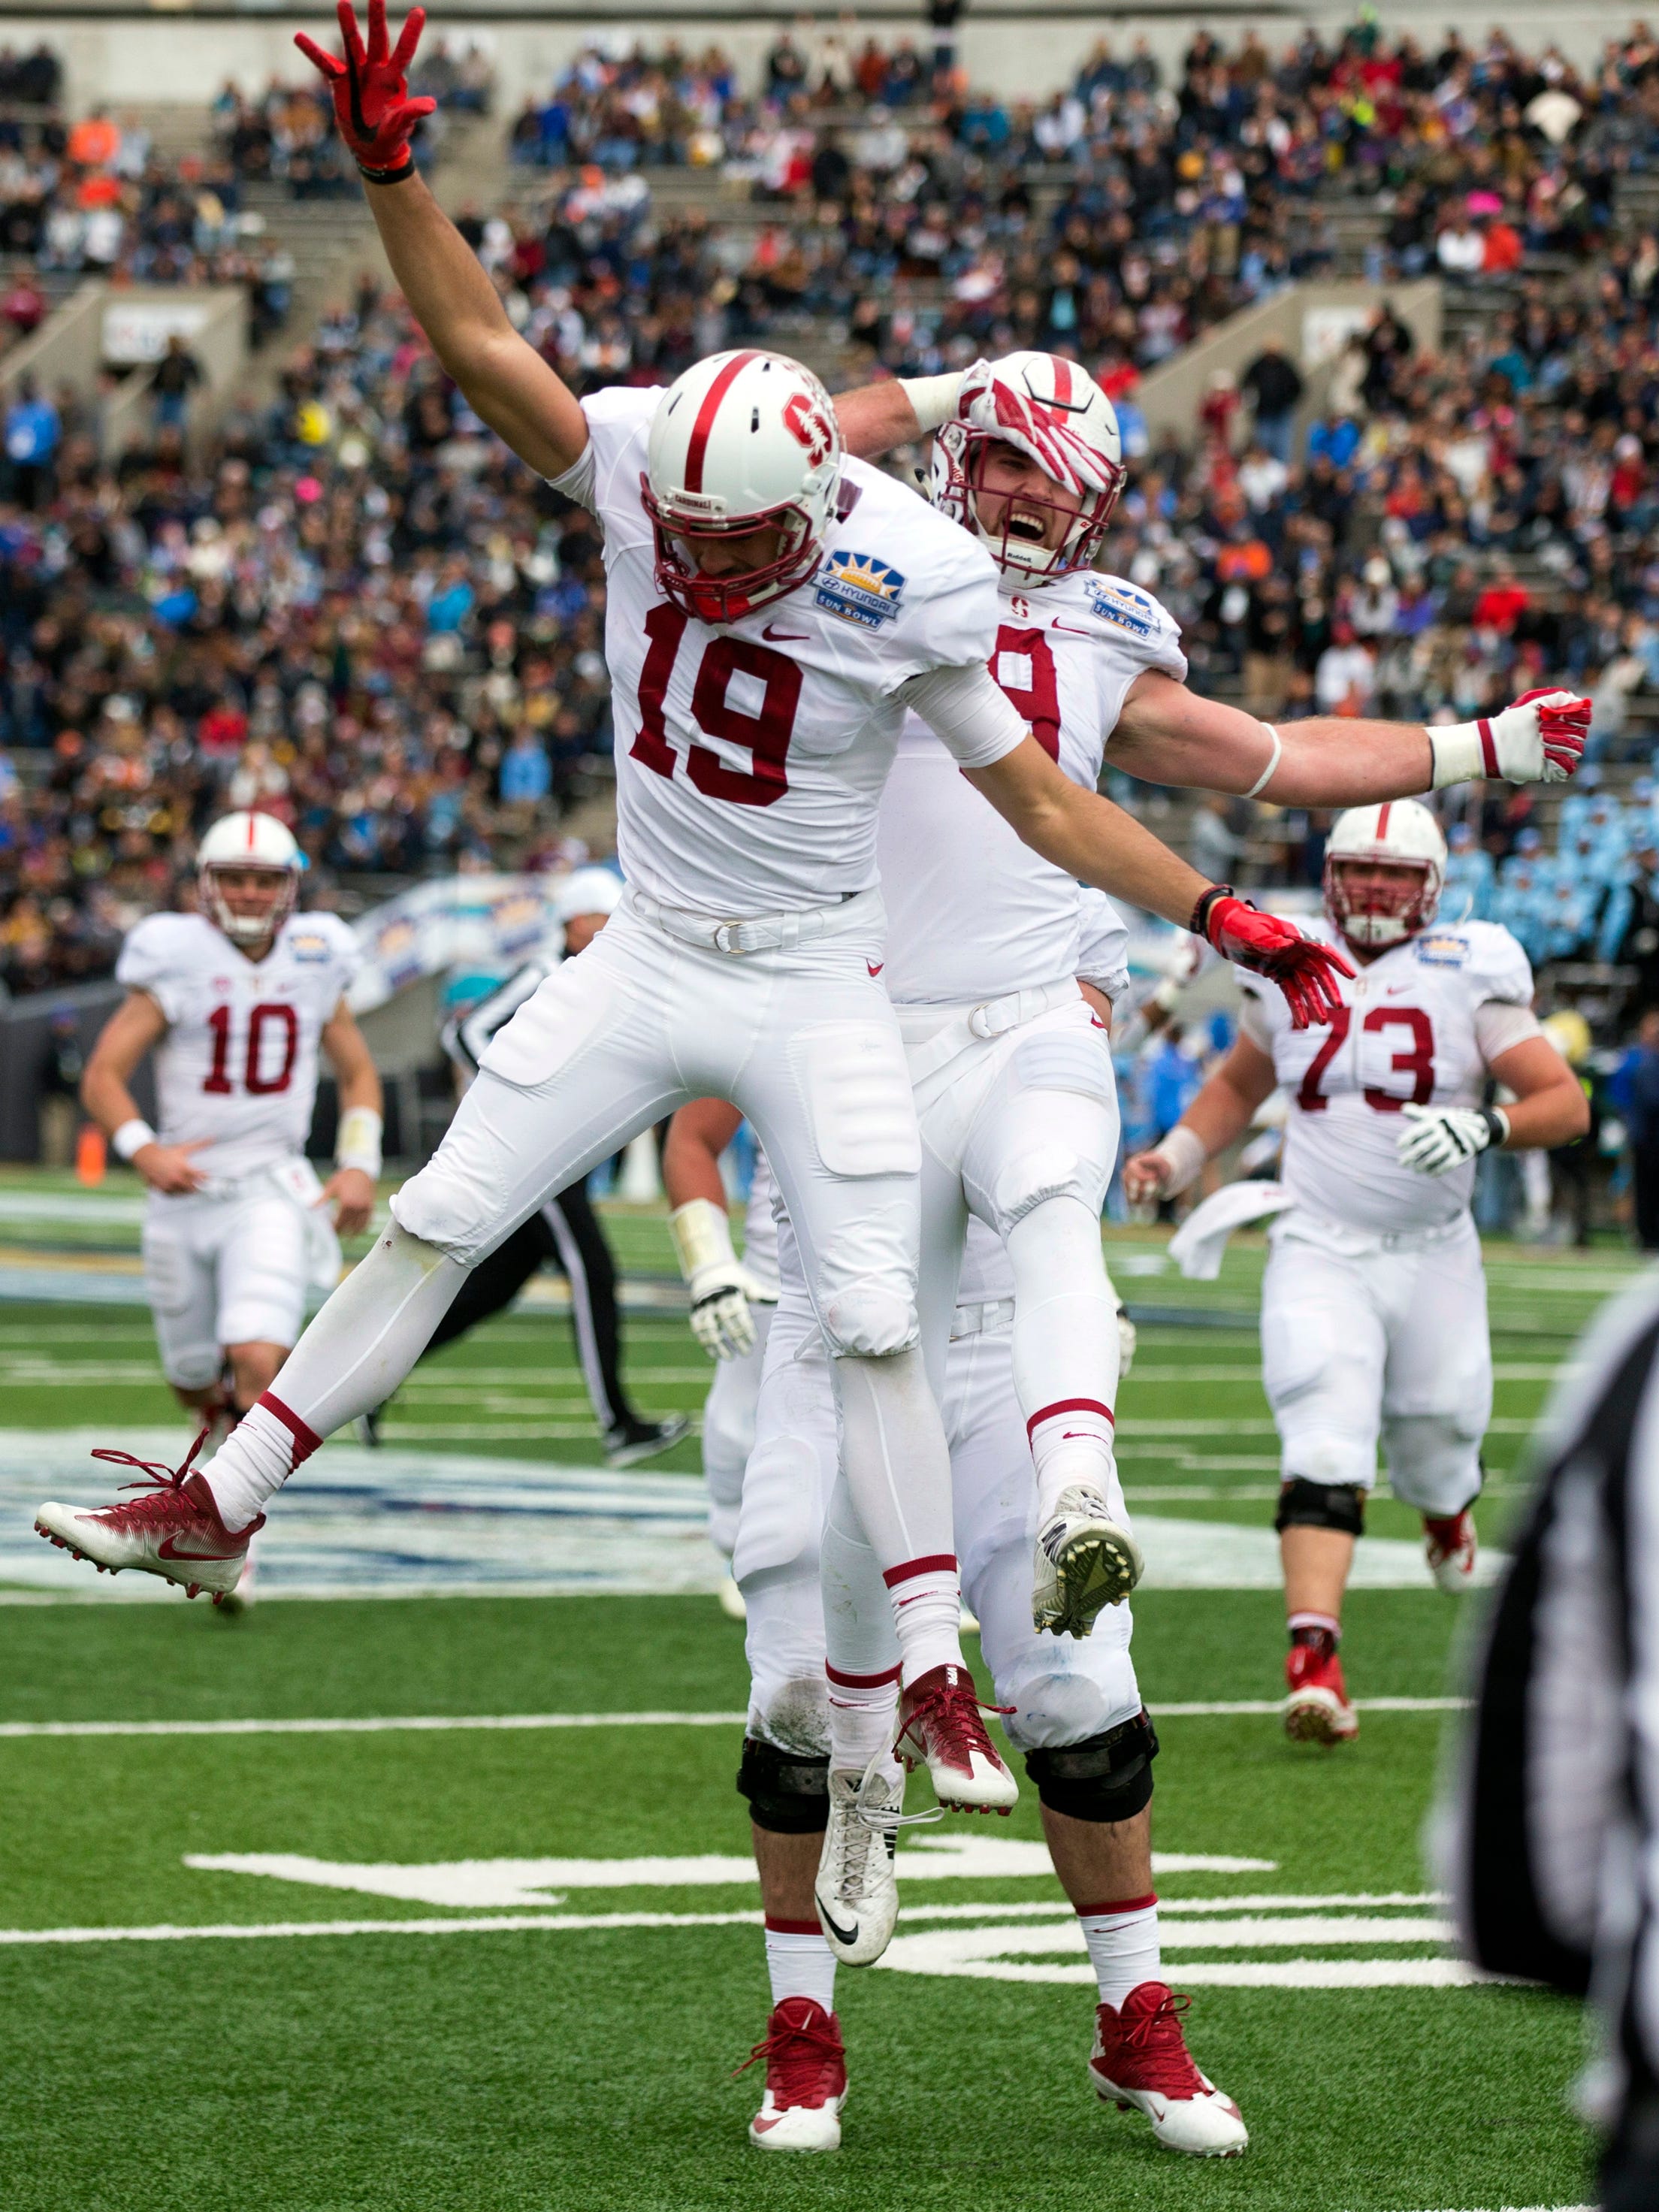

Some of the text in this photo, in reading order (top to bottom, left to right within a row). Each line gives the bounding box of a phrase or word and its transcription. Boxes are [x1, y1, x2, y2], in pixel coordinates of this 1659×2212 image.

[817, 595, 878, 627] SUN BOWL
[841, 585, 890, 612] HYUNDAI
[1095, 604, 1147, 636] SUN BOWL
[629, 601, 804, 807] 19
[202, 1003, 298, 1095] 10
[1292, 1007, 1437, 1112] 73
[880, 1806, 900, 1860] NIE
